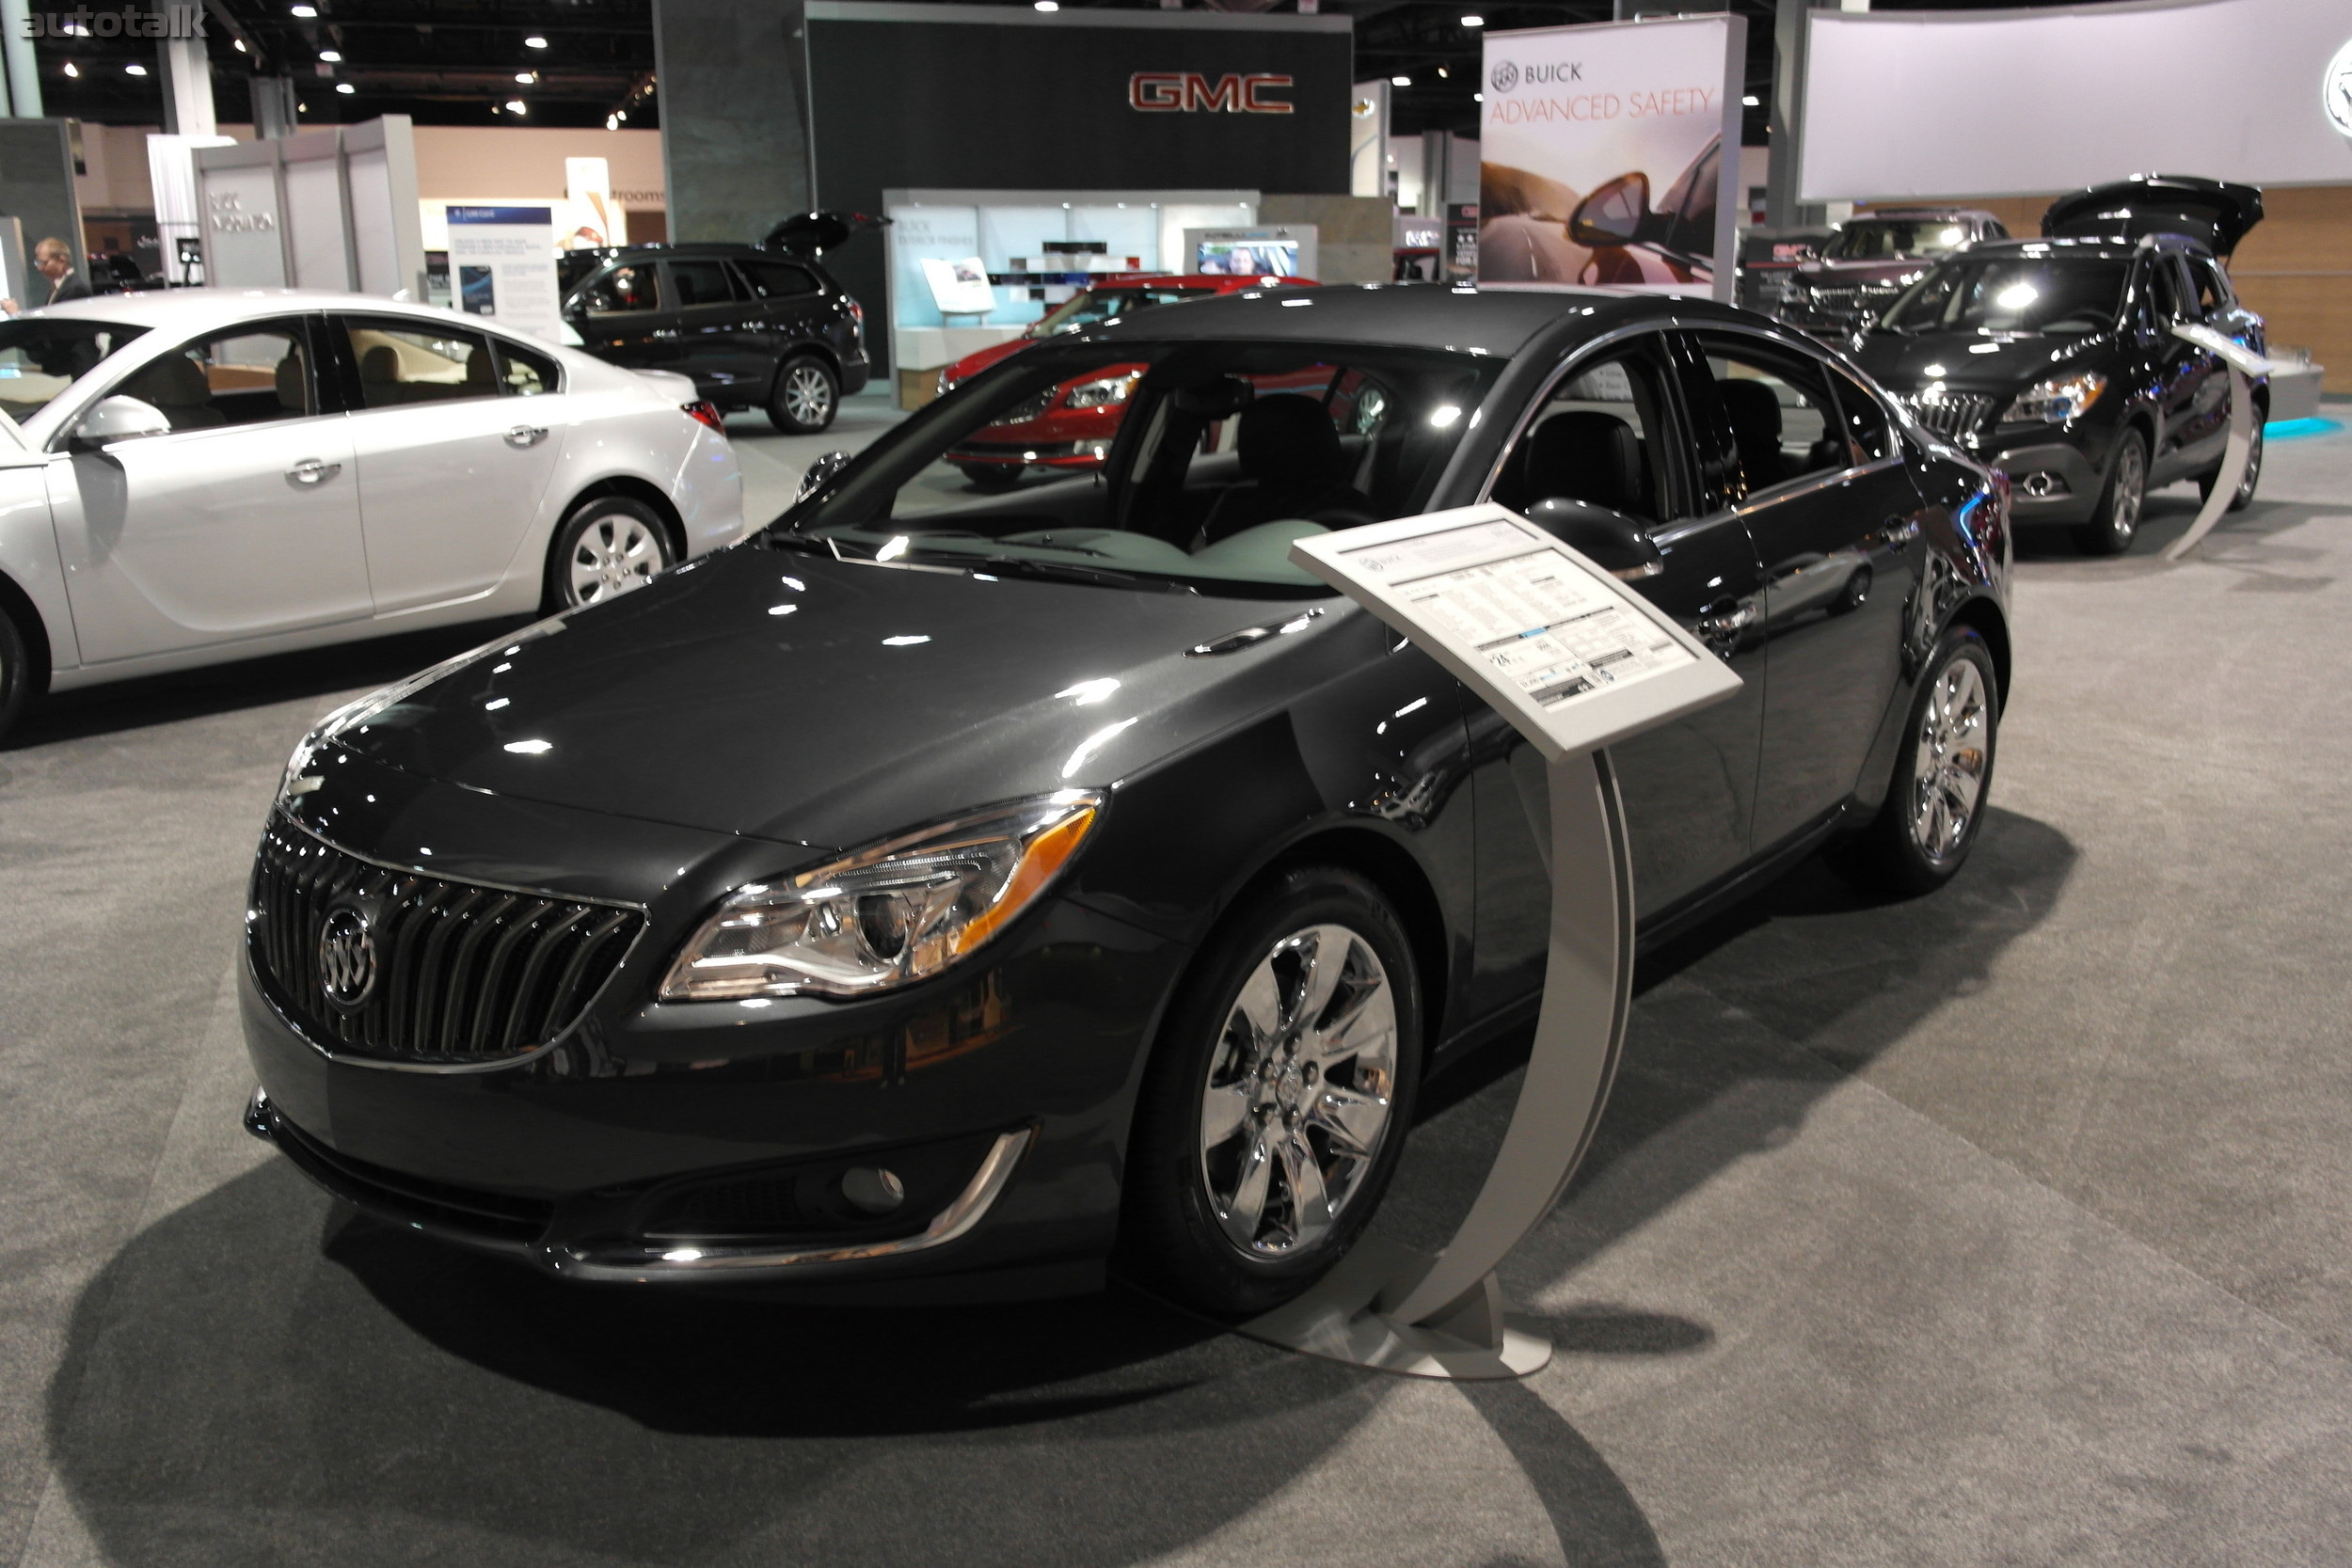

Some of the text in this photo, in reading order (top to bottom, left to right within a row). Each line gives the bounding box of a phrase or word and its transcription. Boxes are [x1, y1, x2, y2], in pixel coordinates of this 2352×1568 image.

[1129, 71, 1295, 113] GMC
[1524, 62, 1582, 85] BUICK
[1488, 87, 1714, 125] ADVANCED SAFETY
